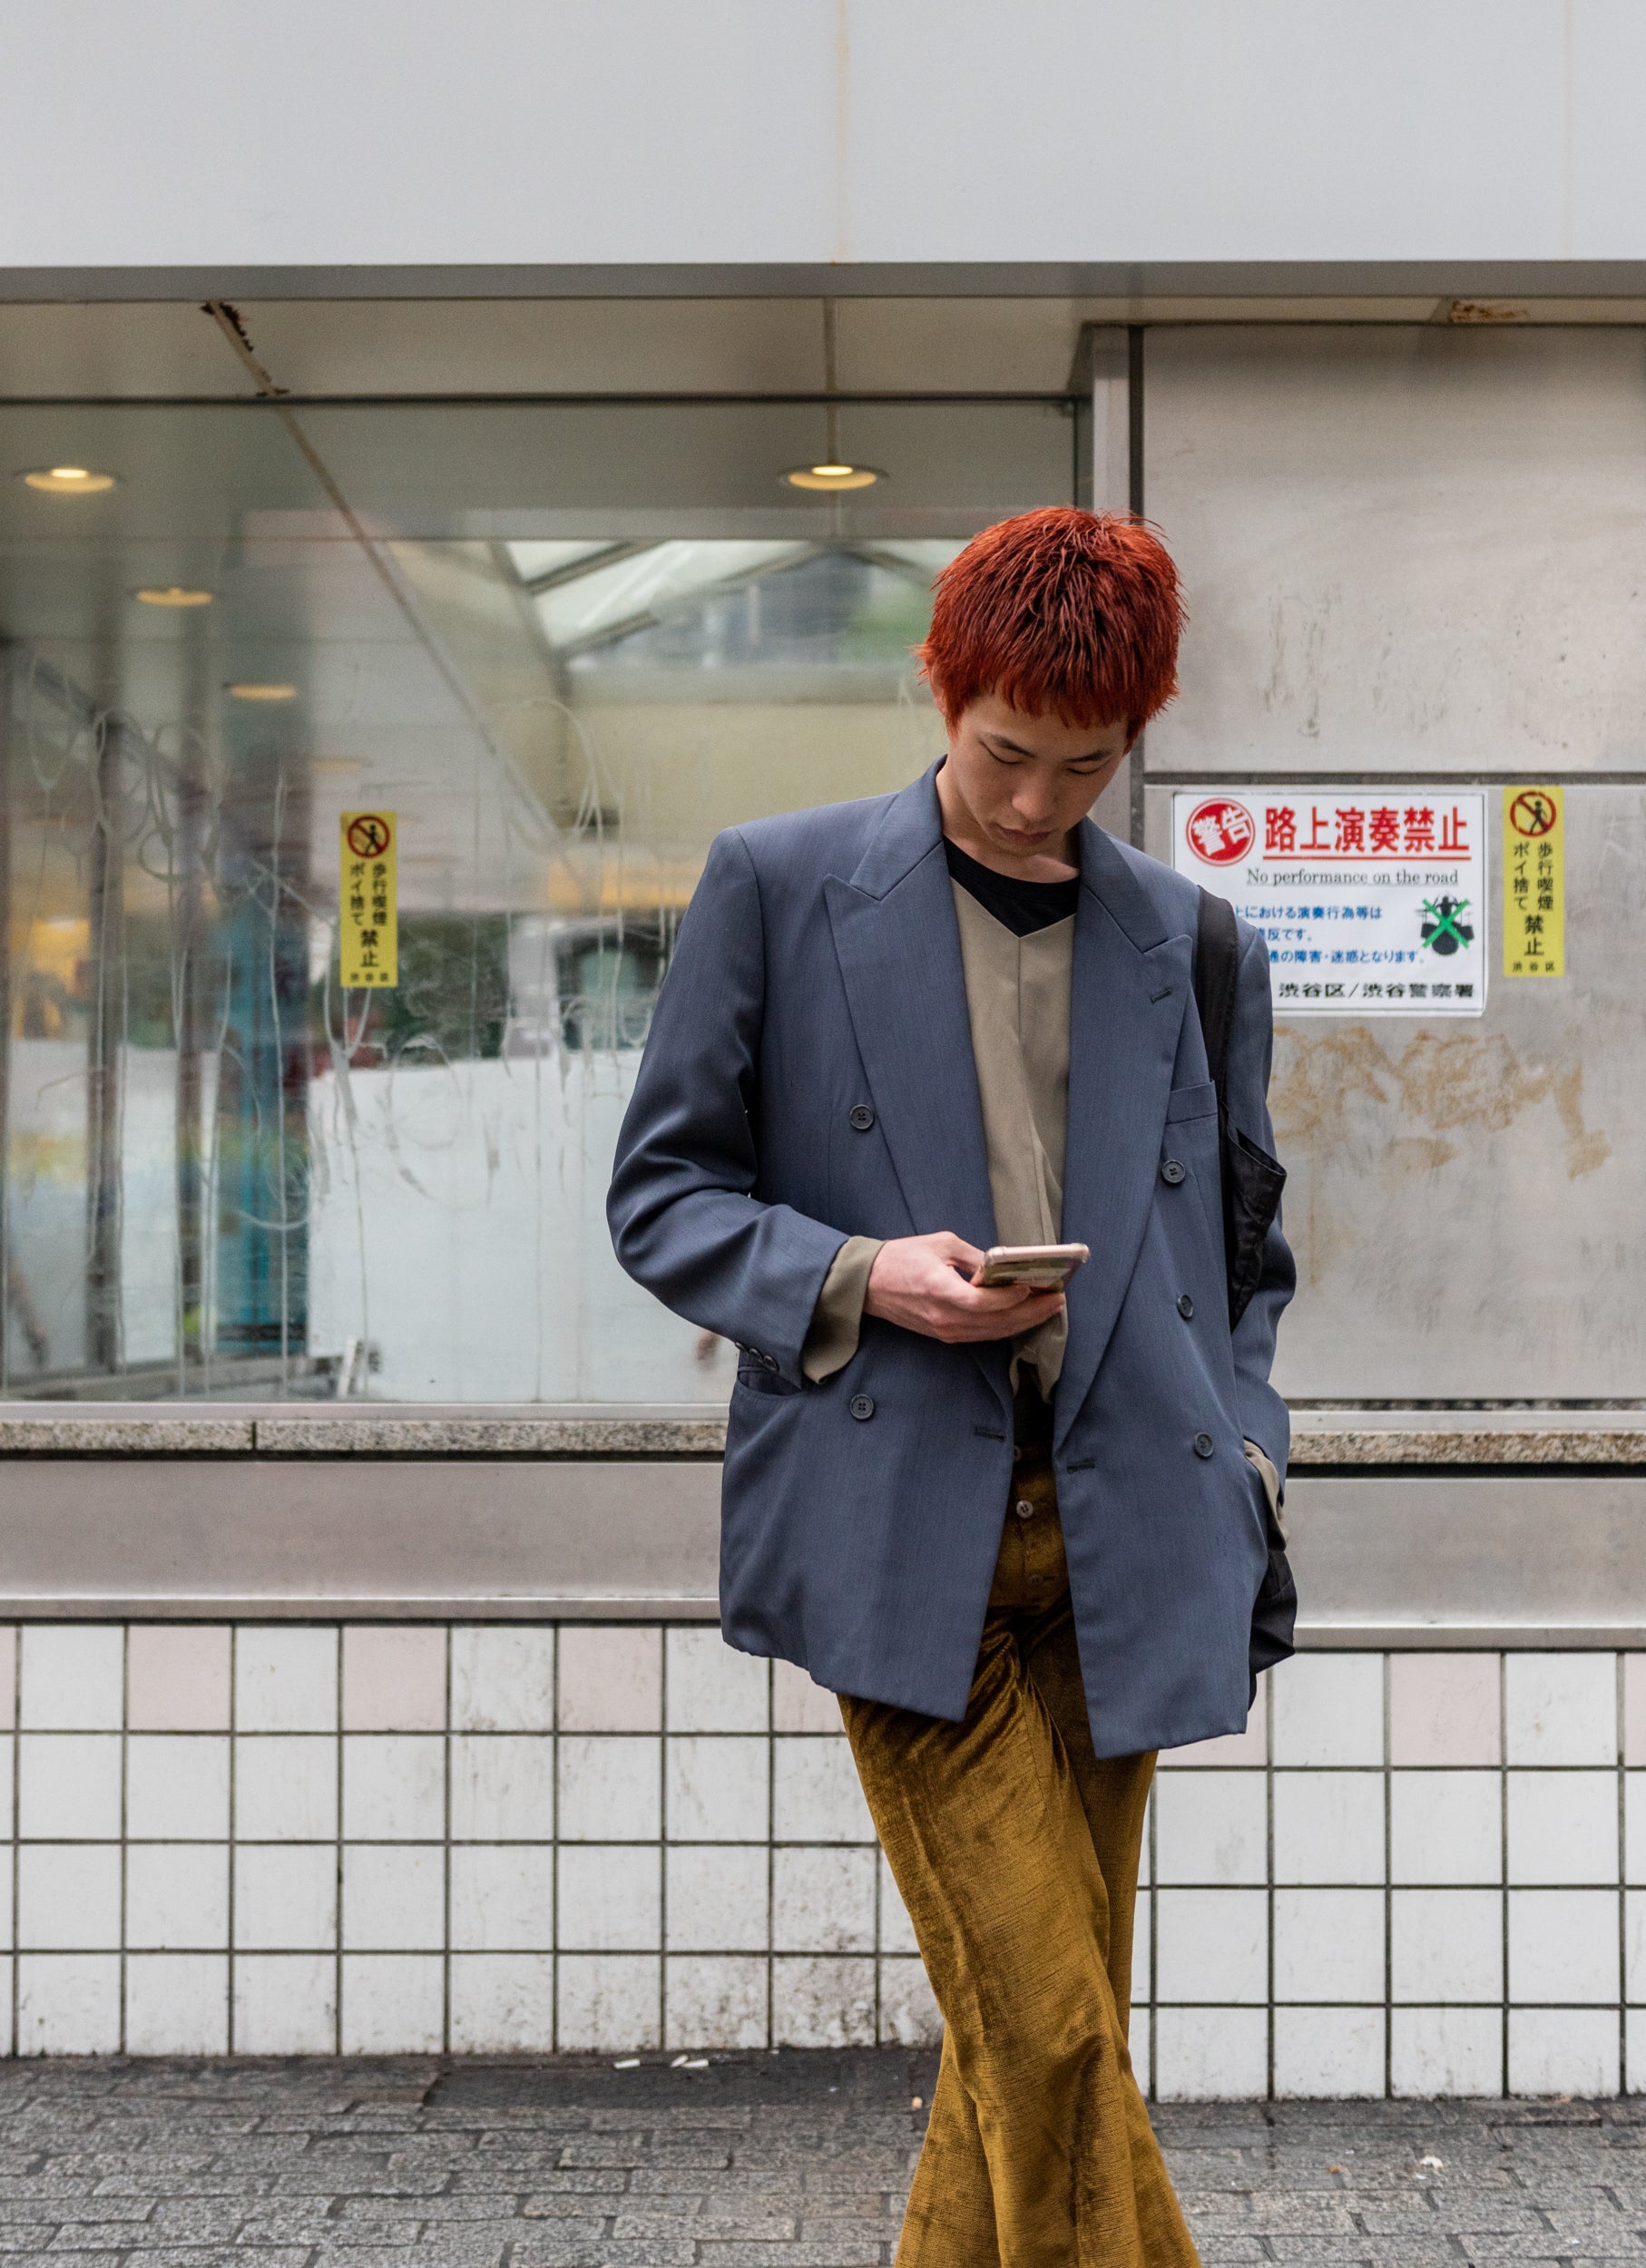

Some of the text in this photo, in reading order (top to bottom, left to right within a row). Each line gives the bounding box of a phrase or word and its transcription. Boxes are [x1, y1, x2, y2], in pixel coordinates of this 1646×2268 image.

[1192, 807, 1250, 856] 警告
[1265, 806, 1470, 852] 路上演奏禁止
[1247, 869, 1458, 886] No performance on the road
[1514, 842, 1530, 910] ポイ捨て
[1537, 842, 1553, 911] 歩行喫煙
[360, 929, 378, 968] 禁止
[1524, 914, 1544, 956] 禁止
